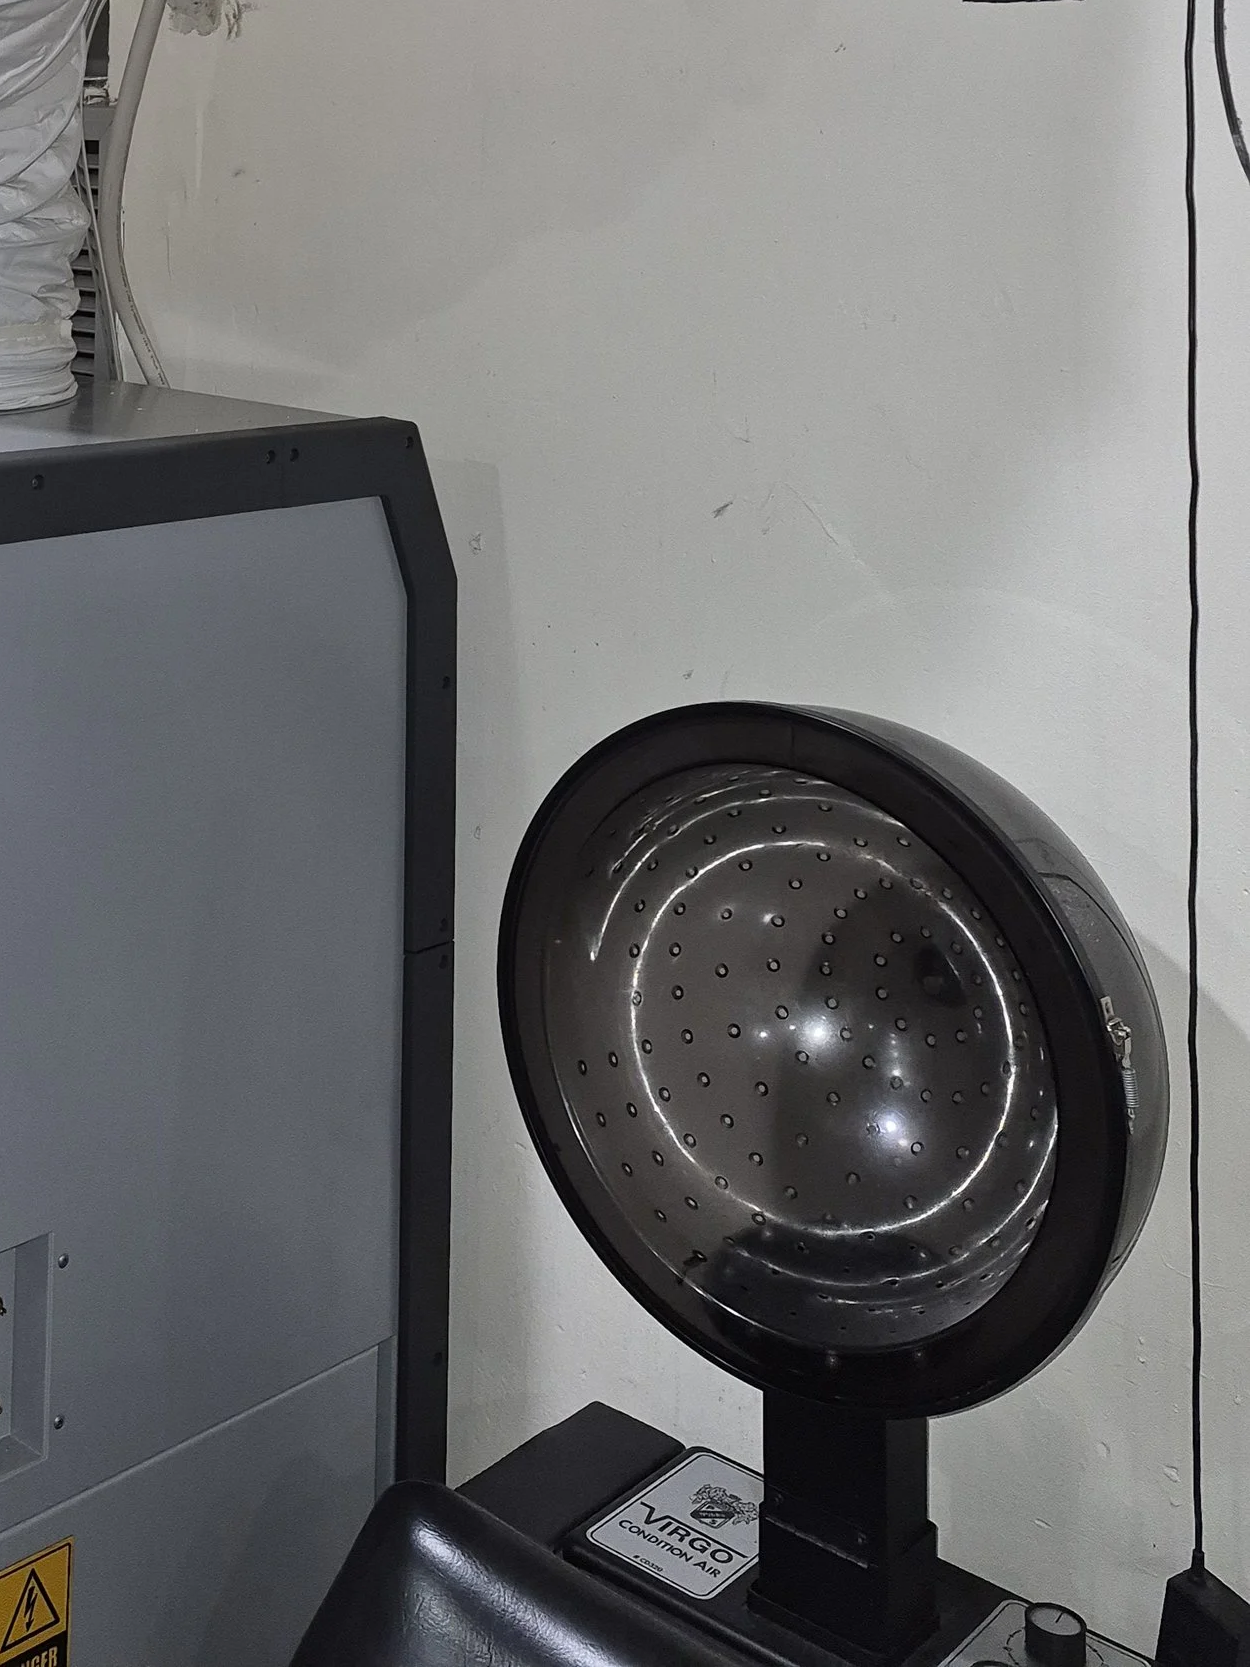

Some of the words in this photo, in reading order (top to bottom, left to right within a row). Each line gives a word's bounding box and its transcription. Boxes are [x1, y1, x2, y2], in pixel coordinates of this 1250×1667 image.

[618, 1519, 693, 1562] CONDITION
[693, 1561, 721, 1578] AIR
[640, 1501, 740, 1563] VIRGO
